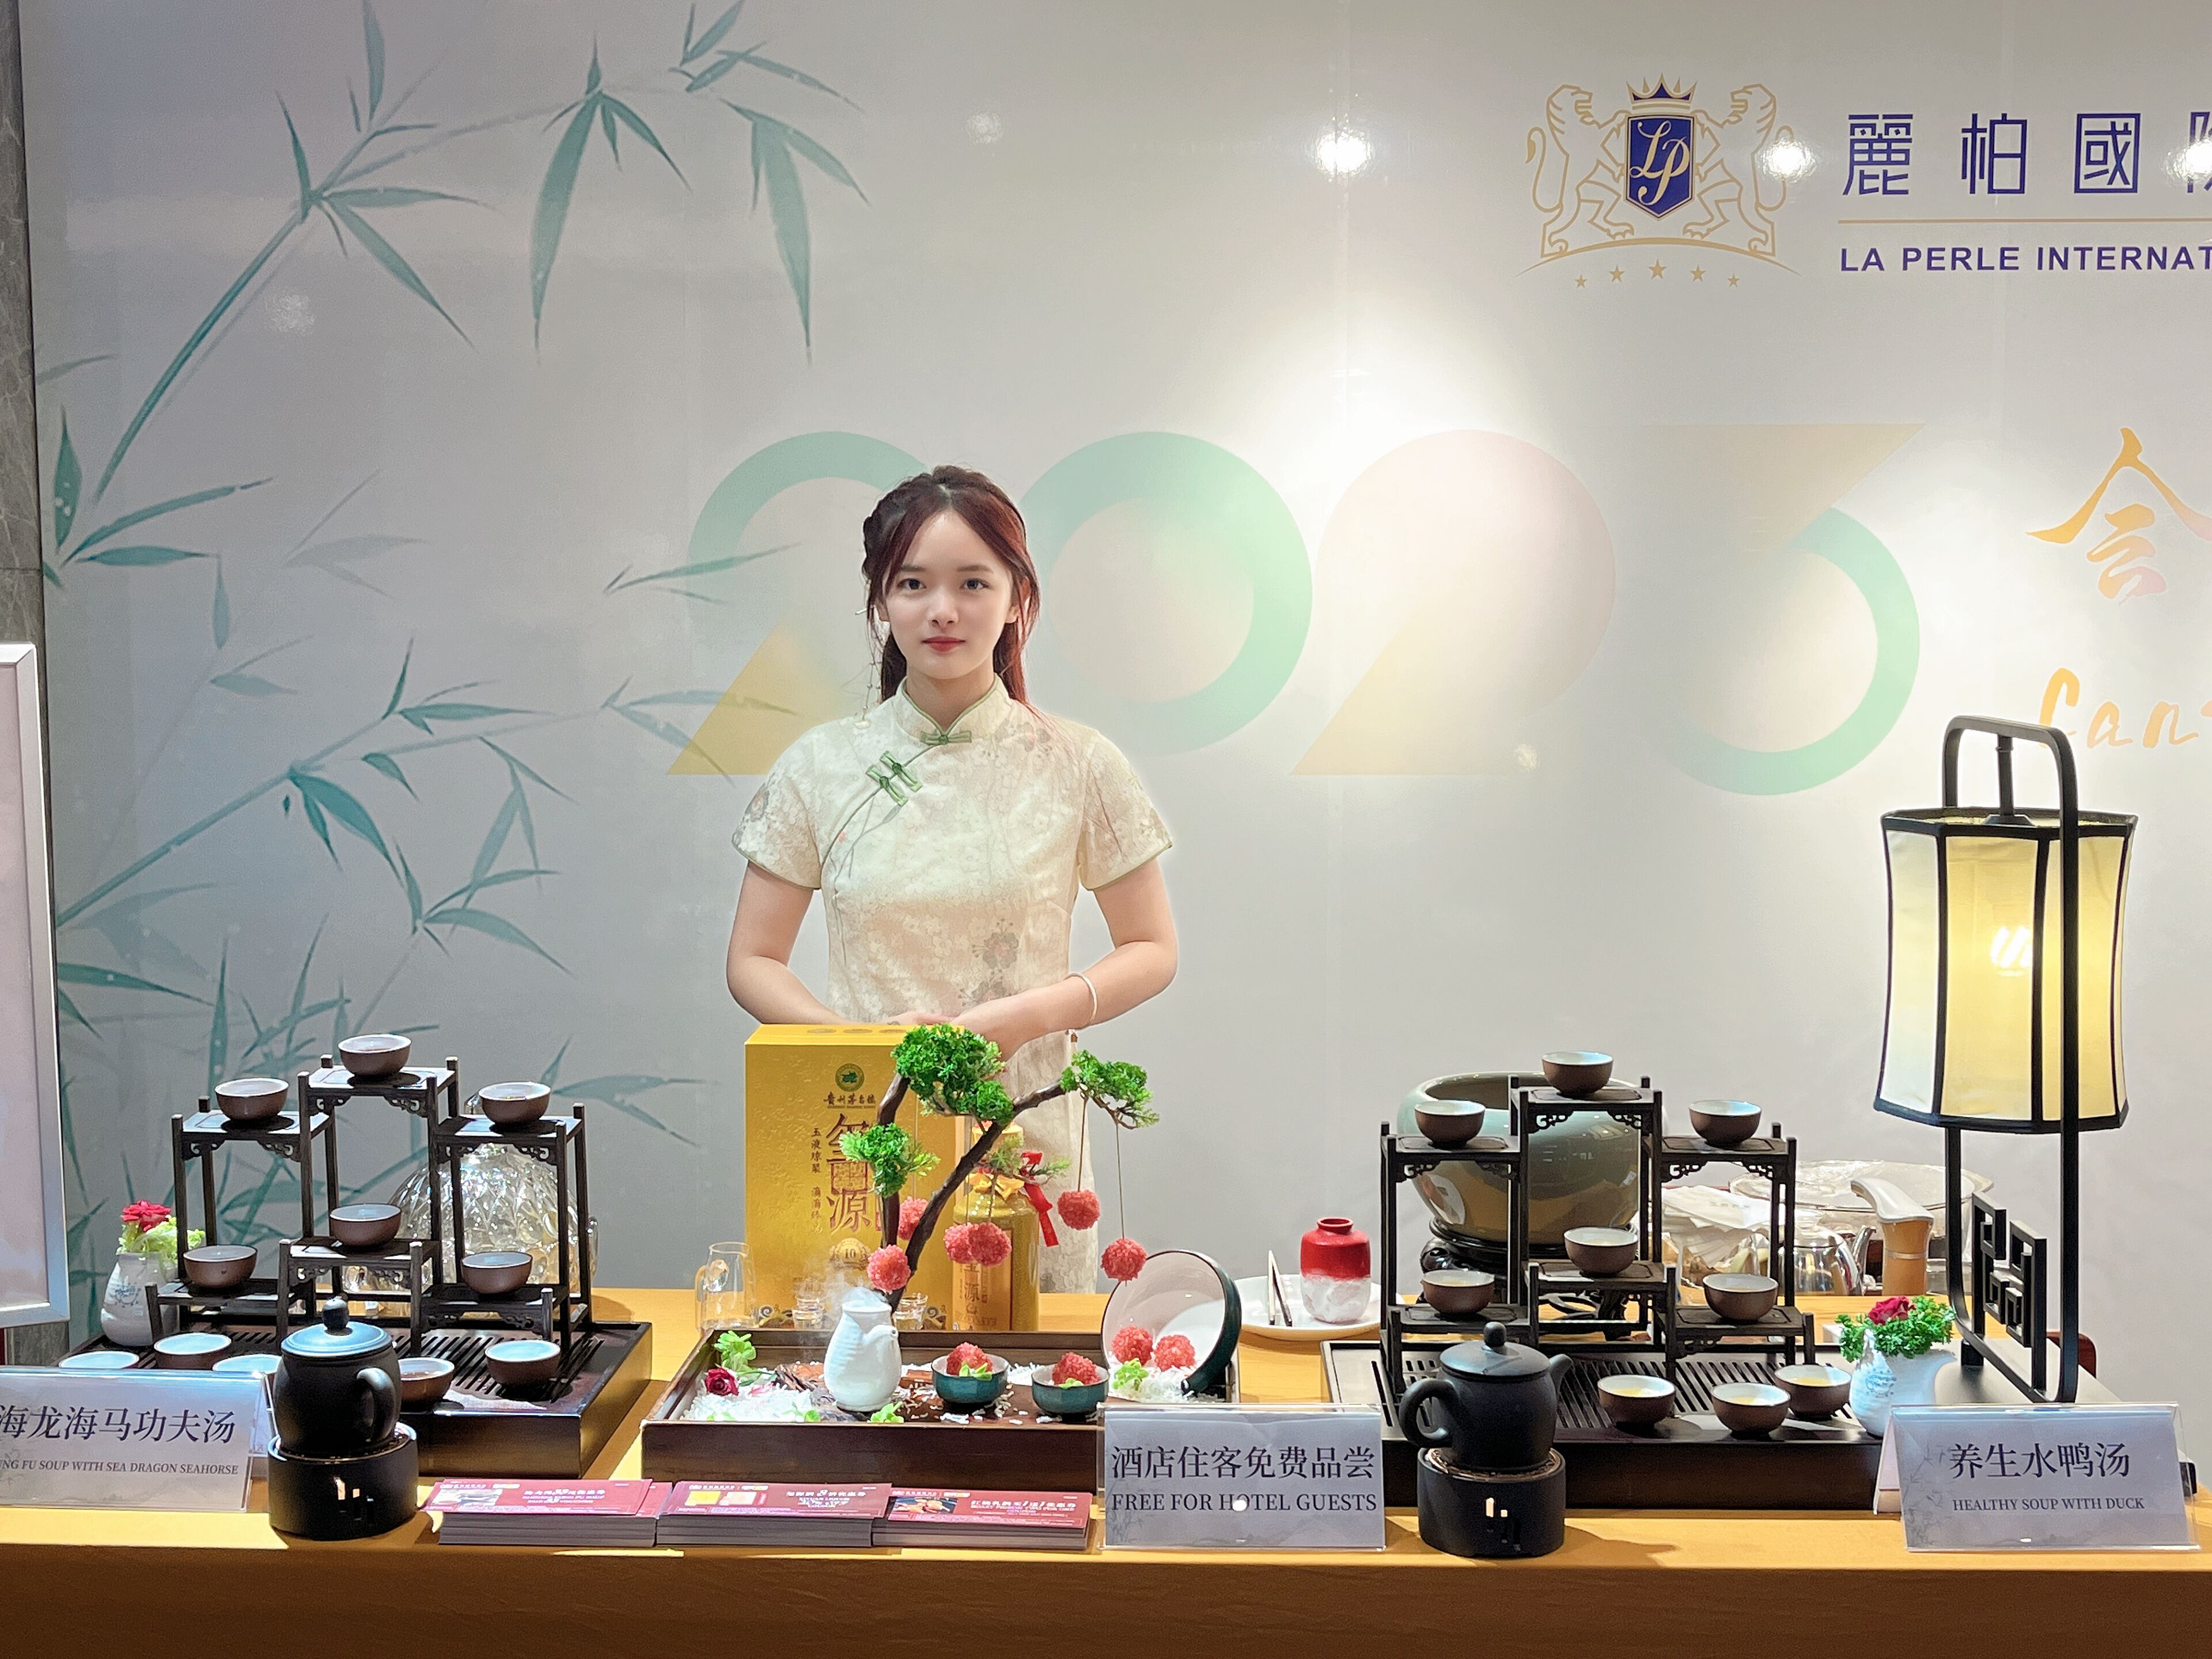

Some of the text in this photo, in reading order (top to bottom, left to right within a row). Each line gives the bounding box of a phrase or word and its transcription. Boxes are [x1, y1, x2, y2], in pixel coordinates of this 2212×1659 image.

[1842, 111, 2212, 195] 麗柏國
[1841, 248, 1884, 271] LA
[1902, 247, 2019, 271] PERLE
[0, 1404, 235, 1443] 海龙海马功夫汤
[22, 1460, 37, 1470] FU
[39, 1460, 69, 1471] SOUP
[73, 1461, 104, 1471] WITH
[106, 1462, 126, 1472] SEA
[130, 1463, 177, 1473] DRAGON
[180, 1464, 238, 1475] SEAHORSE
[1112, 1445, 1374, 1479] 酒店住客免费品尝
[1949, 1442, 2129, 1479] 养生水鸭汤
[1112, 1494, 1377, 1512] FREE FOR HOTEL GUESTS
[1952, 1497, 2145, 1511] HEALTHY SOUP WITH DUCK
